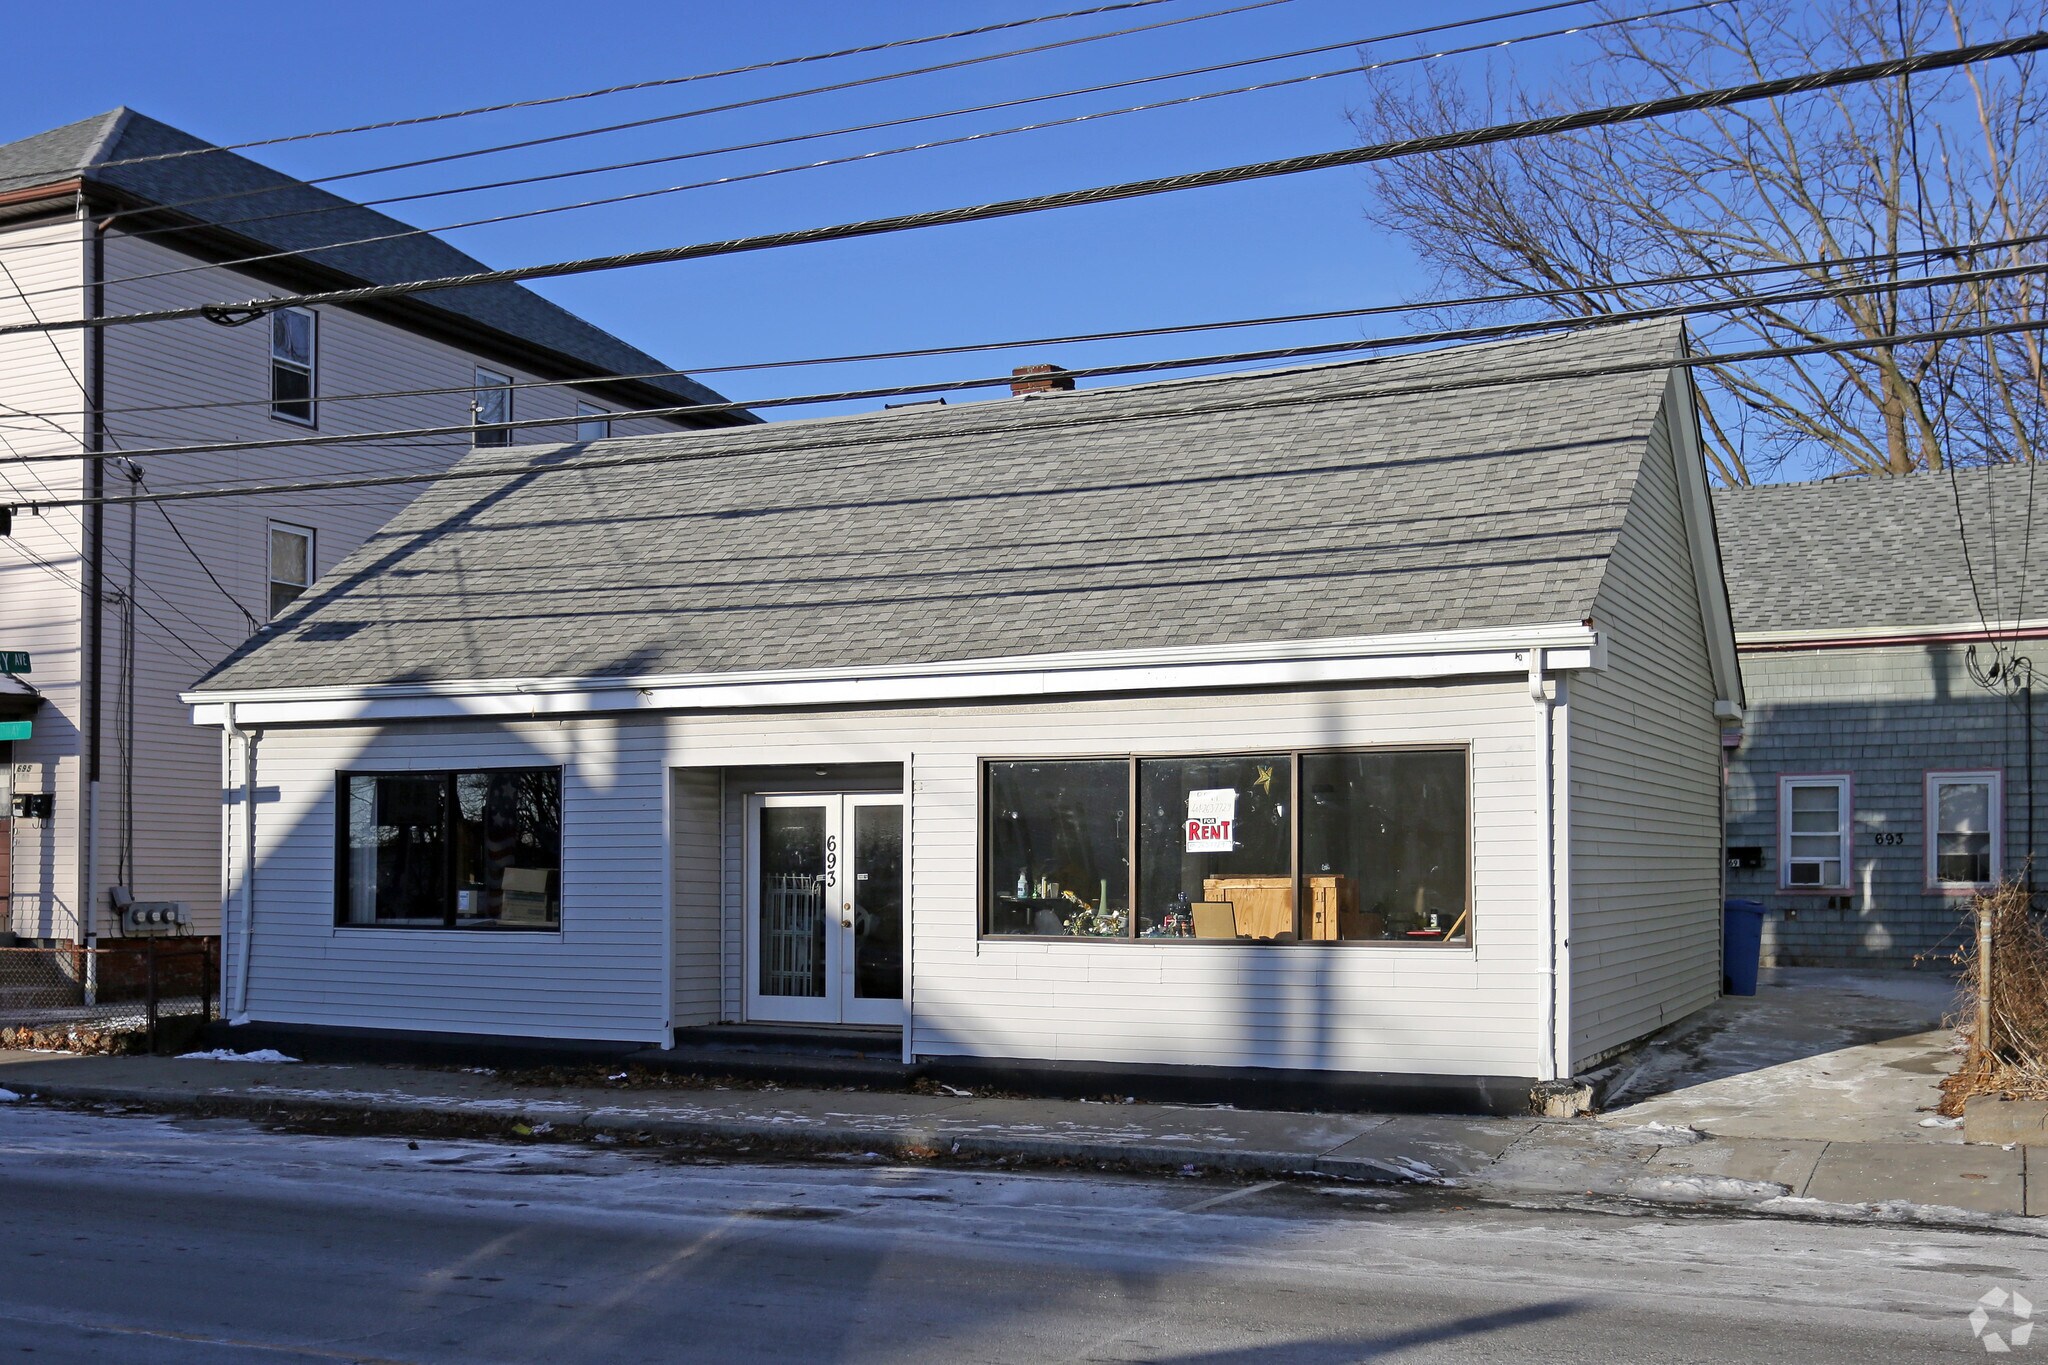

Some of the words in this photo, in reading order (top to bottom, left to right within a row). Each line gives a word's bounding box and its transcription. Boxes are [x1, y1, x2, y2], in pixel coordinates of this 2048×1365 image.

[14, 653, 27, 666] AVE
[17, 765, 32, 773] 695
[1189, 821, 1230, 841] RENT
[1875, 833, 1904, 845] 693
[827, 835, 836, 888] 693
